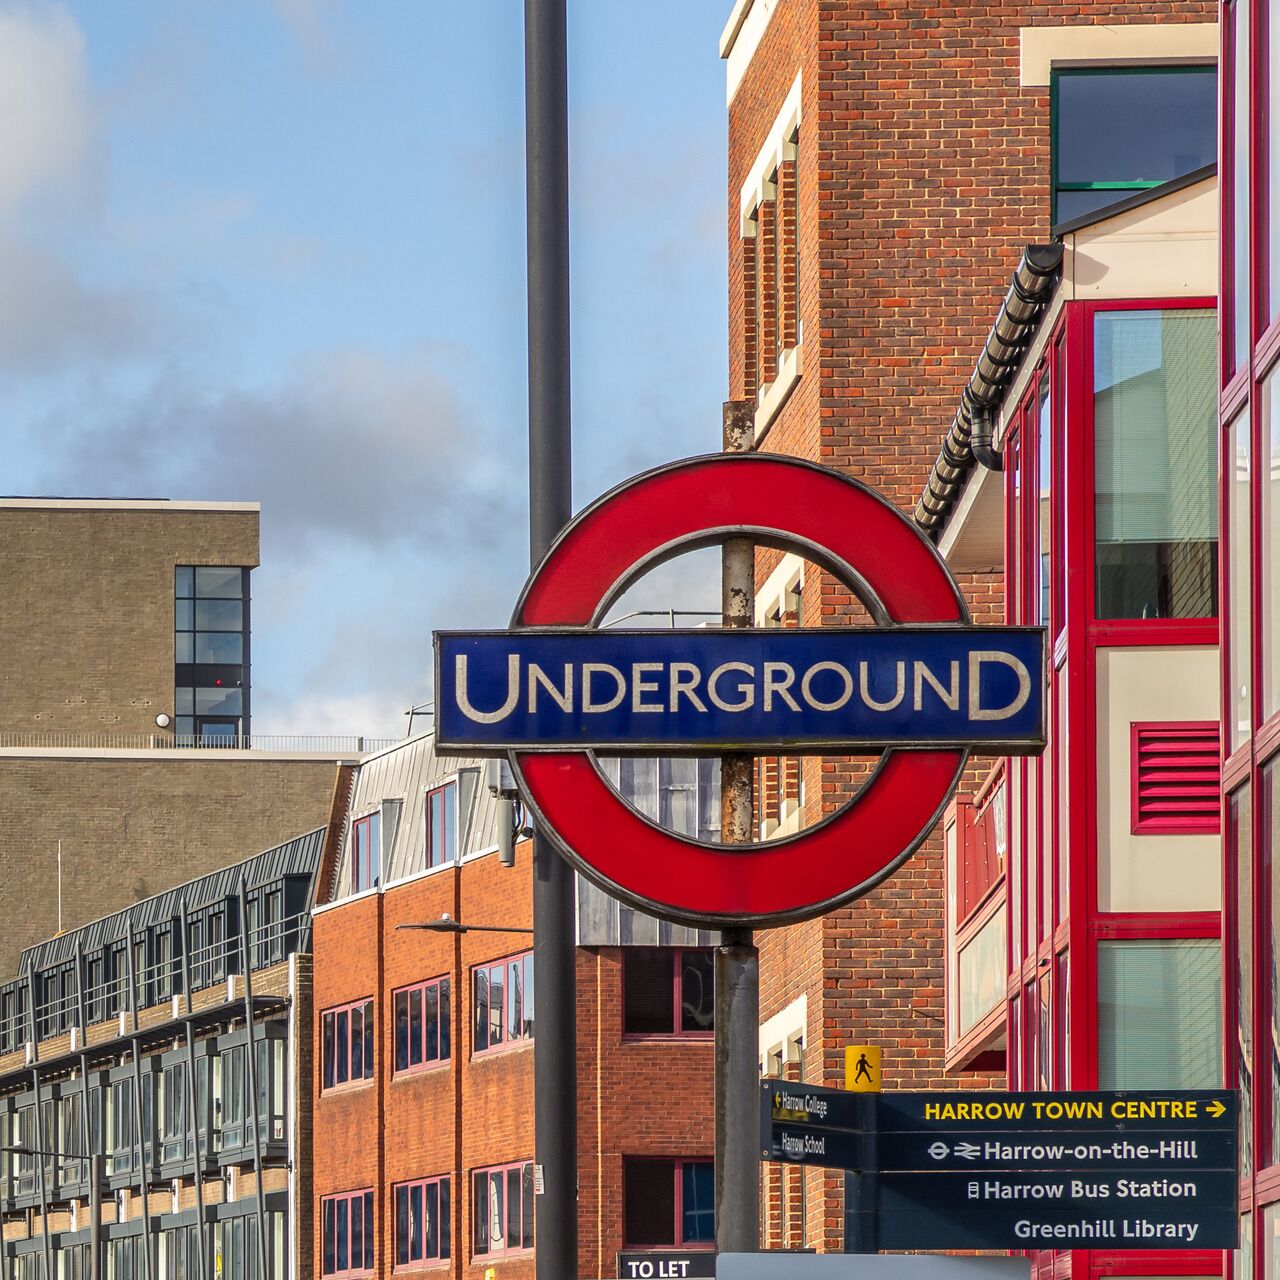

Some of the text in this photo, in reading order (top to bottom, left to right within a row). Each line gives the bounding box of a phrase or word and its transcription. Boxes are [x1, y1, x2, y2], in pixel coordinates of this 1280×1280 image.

[456, 651, 1031, 724] UNDERGROUND
[782, 1091, 828, 1119] Harrow College
[925, 1101, 1198, 1120] HARROW TOWN CENTRE
[782, 1132, 825, 1155] Harrow School
[984, 1140, 1198, 1160] Harrow-on-the-Hill
[984, 1179, 1197, 1199] Harrow Bus Station
[1014, 1219, 1199, 1241] Greenhill Library
[628, 1260, 690, 1278] TO LET
